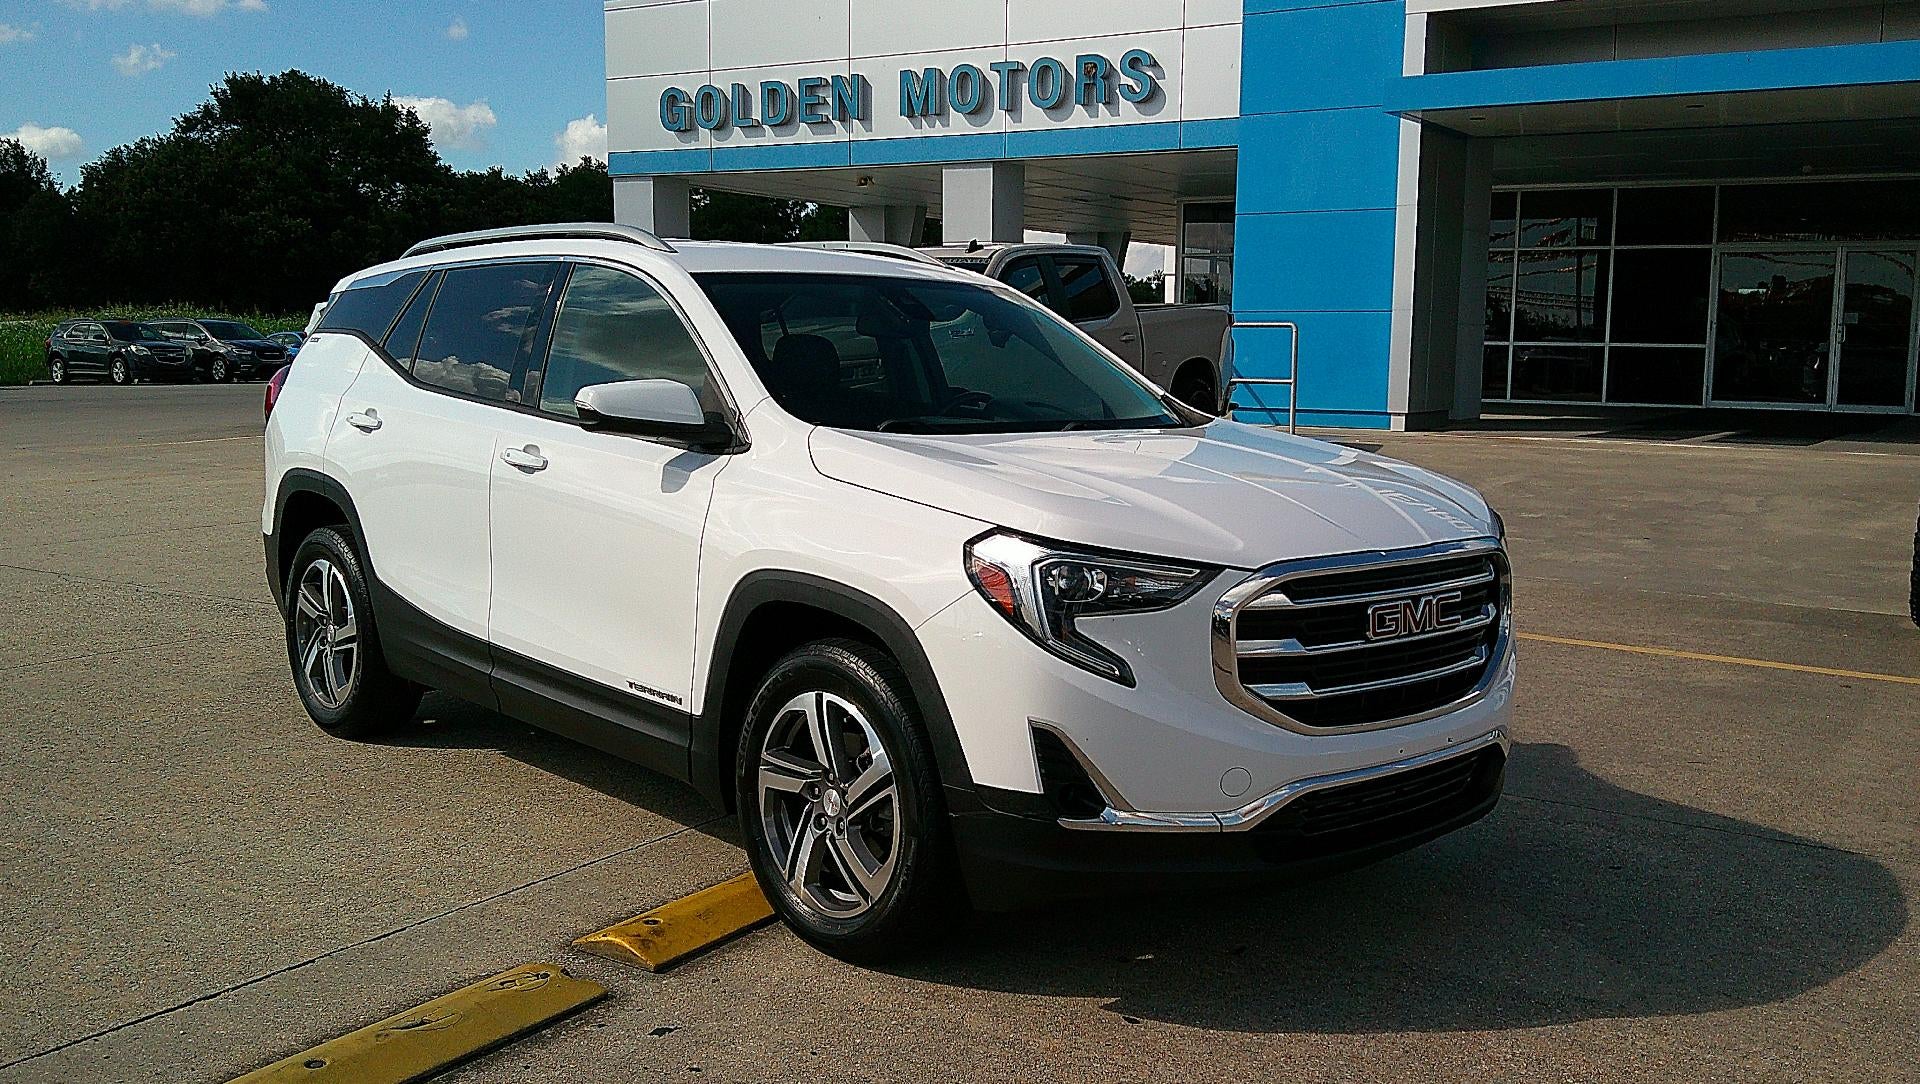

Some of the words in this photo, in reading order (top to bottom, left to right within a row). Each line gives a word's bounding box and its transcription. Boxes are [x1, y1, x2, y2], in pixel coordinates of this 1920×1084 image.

[659, 73, 864, 132] GOLDEN
[899, 48, 1157, 117] MOTORS
[1367, 591, 1462, 640] GMC
[625, 680, 683, 706] TERRAIN
